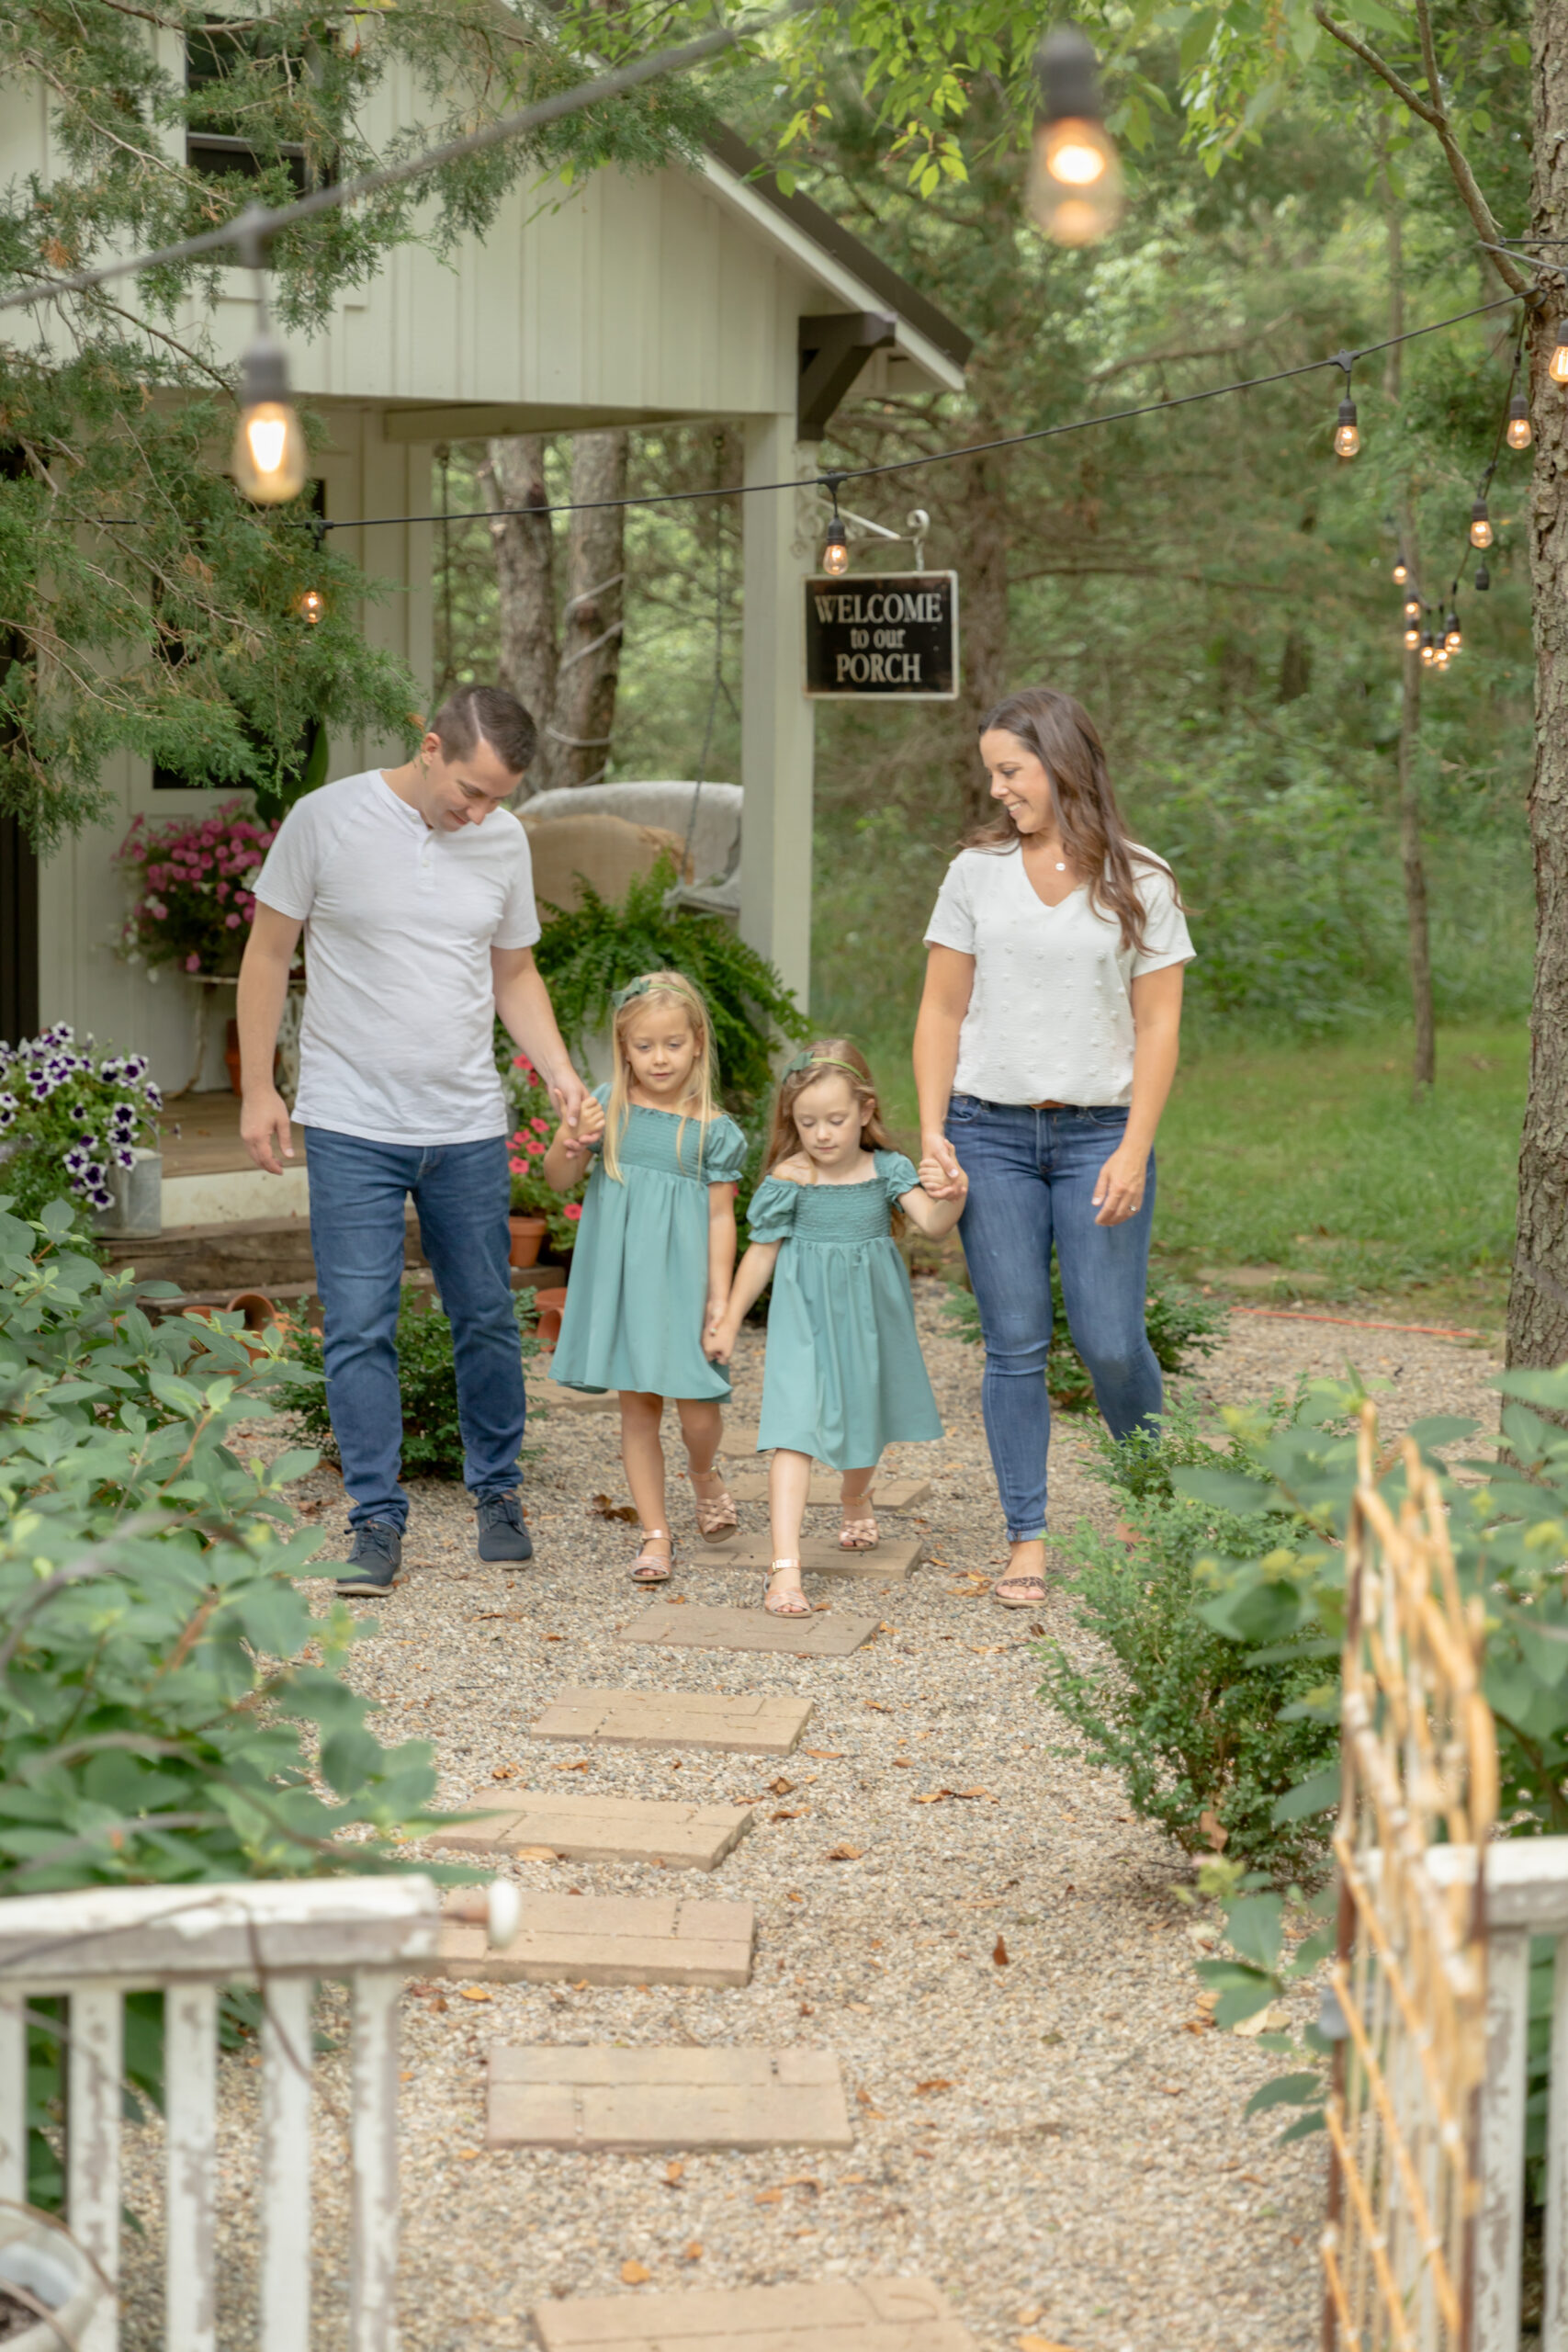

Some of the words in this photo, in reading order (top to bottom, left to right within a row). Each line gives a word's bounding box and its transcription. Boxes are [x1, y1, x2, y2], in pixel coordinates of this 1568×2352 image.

[815, 594, 943, 624] WELCOME
[850, 628, 870, 650] to
[873, 628, 907, 649] our
[836, 653, 922, 683] PORCH
